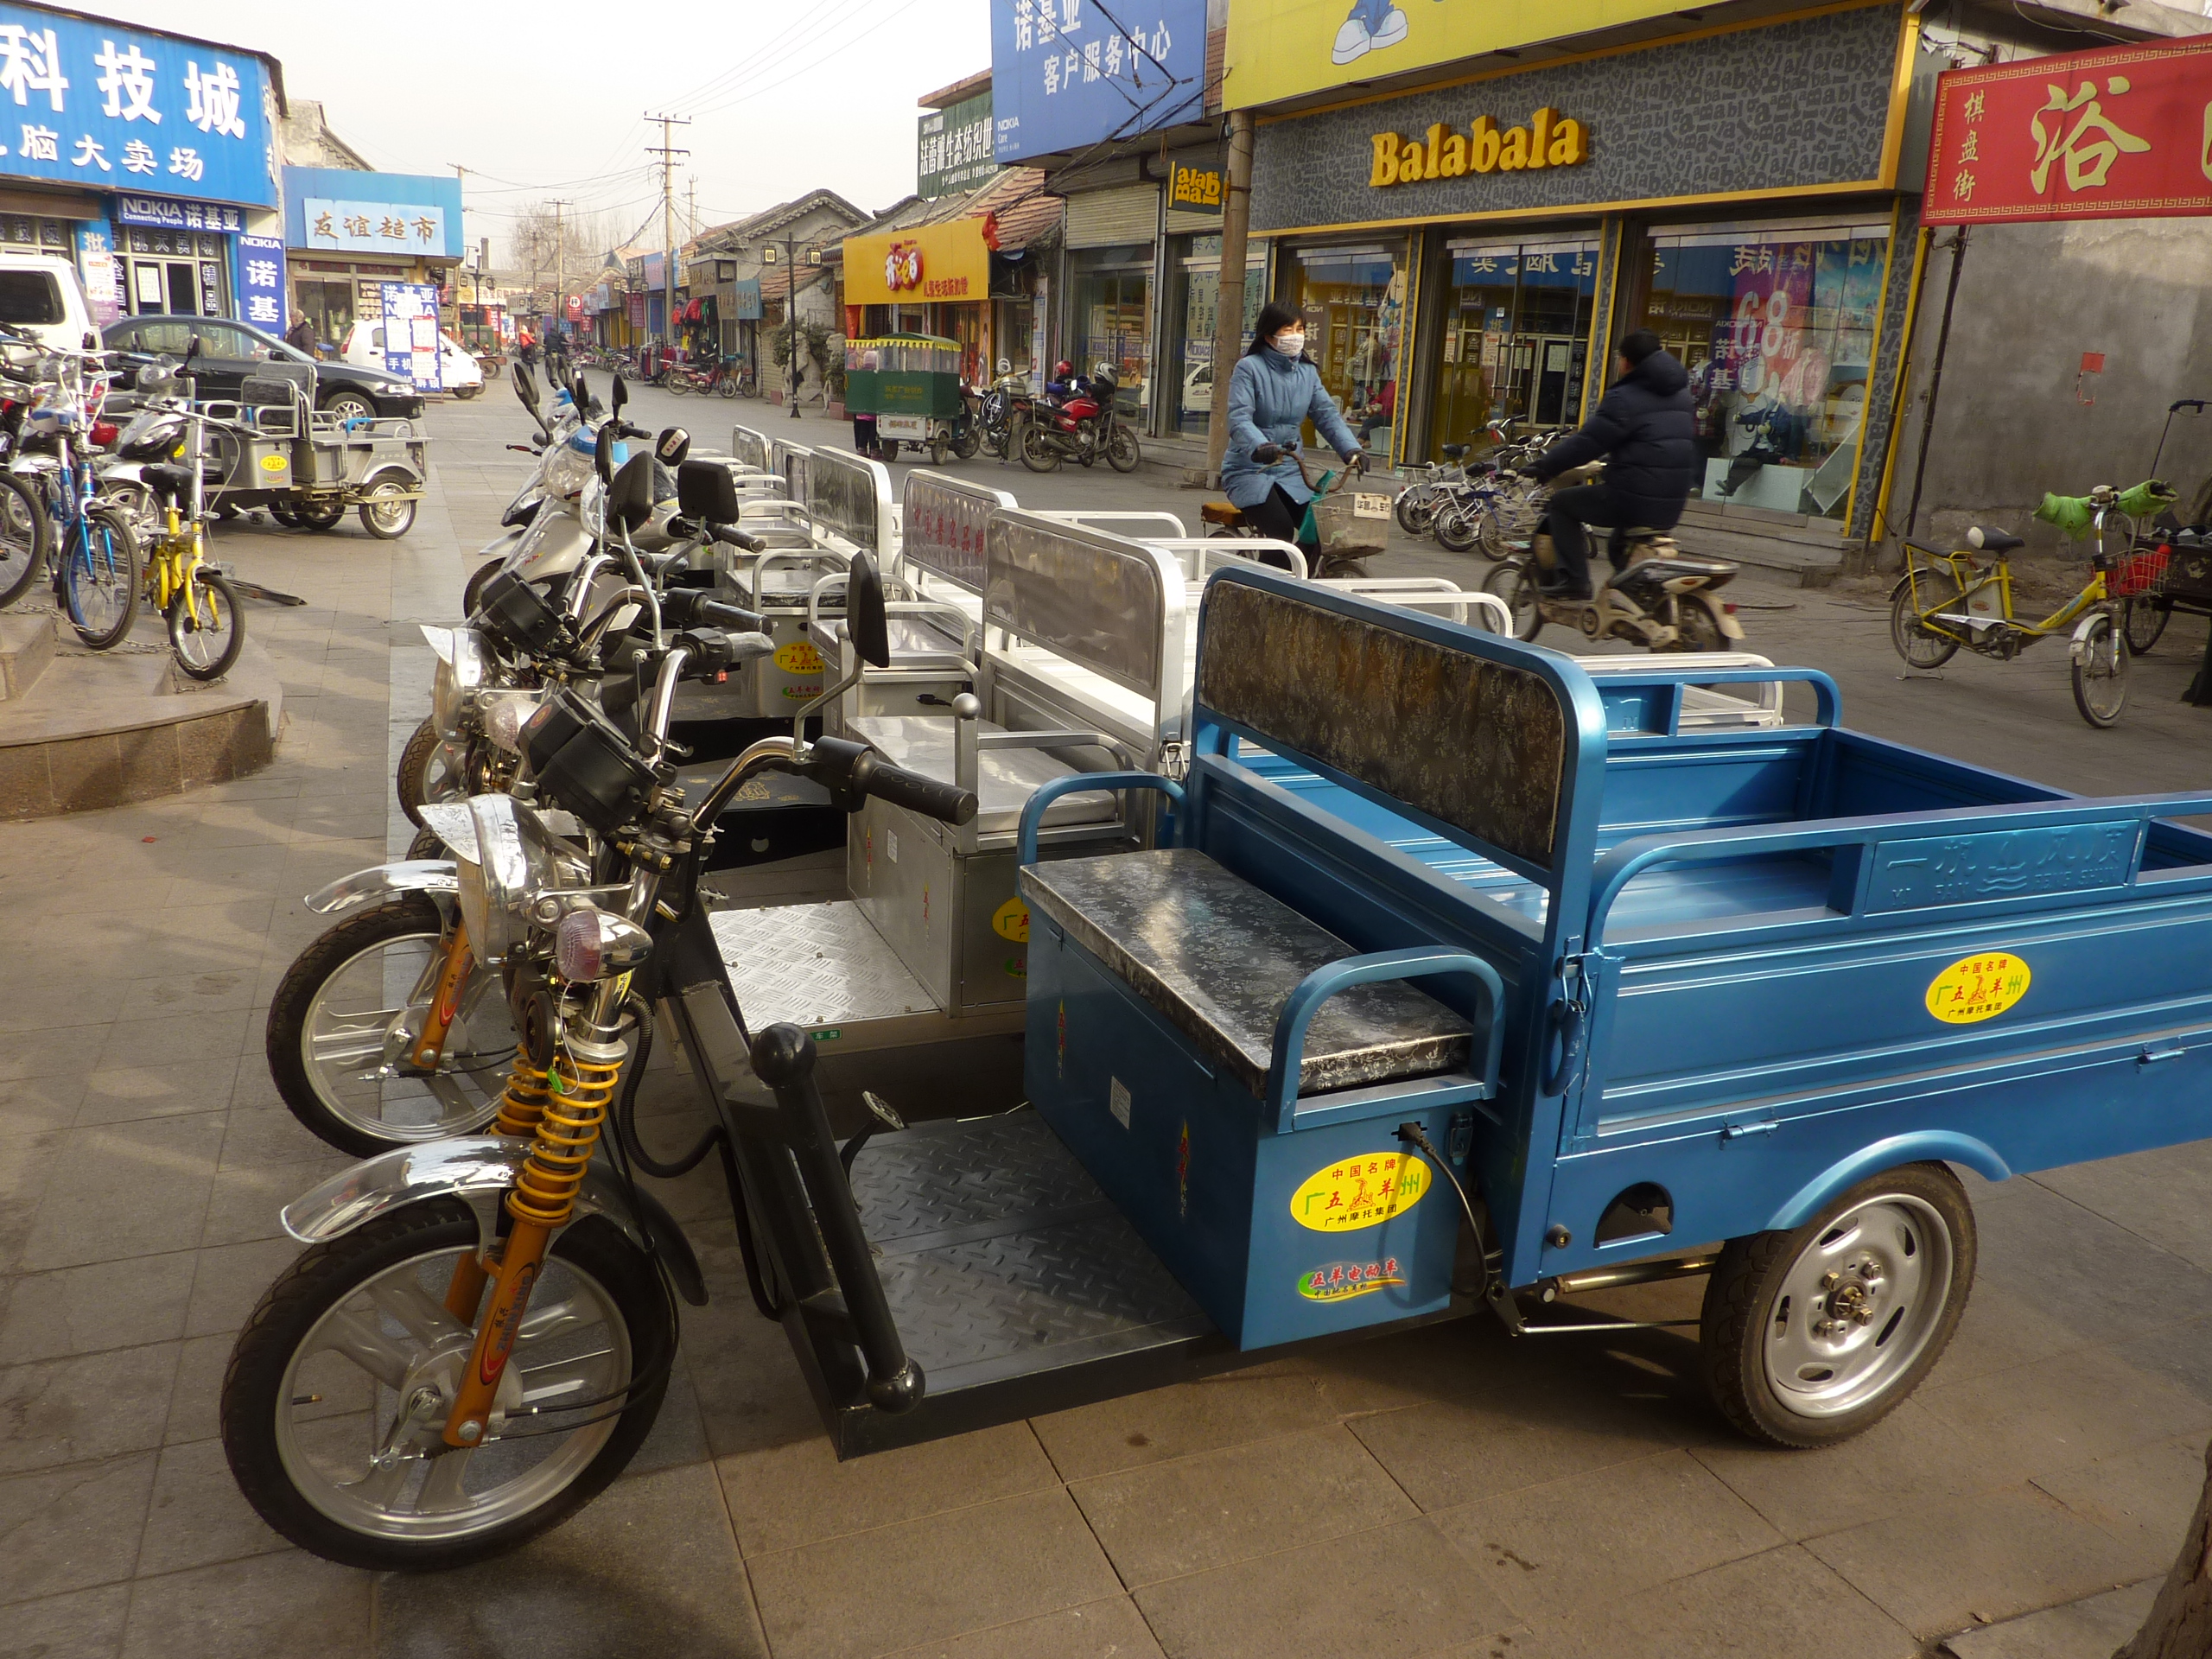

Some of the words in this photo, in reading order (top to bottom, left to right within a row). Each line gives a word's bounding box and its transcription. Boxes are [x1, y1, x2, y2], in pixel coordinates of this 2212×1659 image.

[1014, 0, 1081, 52] 诺基亚
[1044, 19, 1172, 95] 客户服务中心
[0, 25, 245, 139] 科技城
[998, 117, 1020, 131] NOKIA
[2031, 75, 2212, 194] 浴
[0, 124, 203, 181] 脑大卖场
[1369, 106, 1590, 188] Balabala
[1953, 89, 1986, 202] 棋盘街
[123, 198, 182, 218] NOKIA
[124, 212, 162, 224] Connecting
[162, 216, 183, 226] People
[185, 204, 240, 231] 诺基亚
[240, 236, 282, 250] NOKIA
[314, 210, 437, 245] 友谊超市
[245, 260, 280, 339] 诺基
[1960, 959, 2007, 976] 中国名牌
[1947, 1002, 2003, 1018] 广州摩托集团
[1332, 1159, 1397, 1181] 中国名牌
[1324, 1204, 1397, 1227] 广州摩托集团
[1309, 1257, 1398, 1288] 五羊电动车
